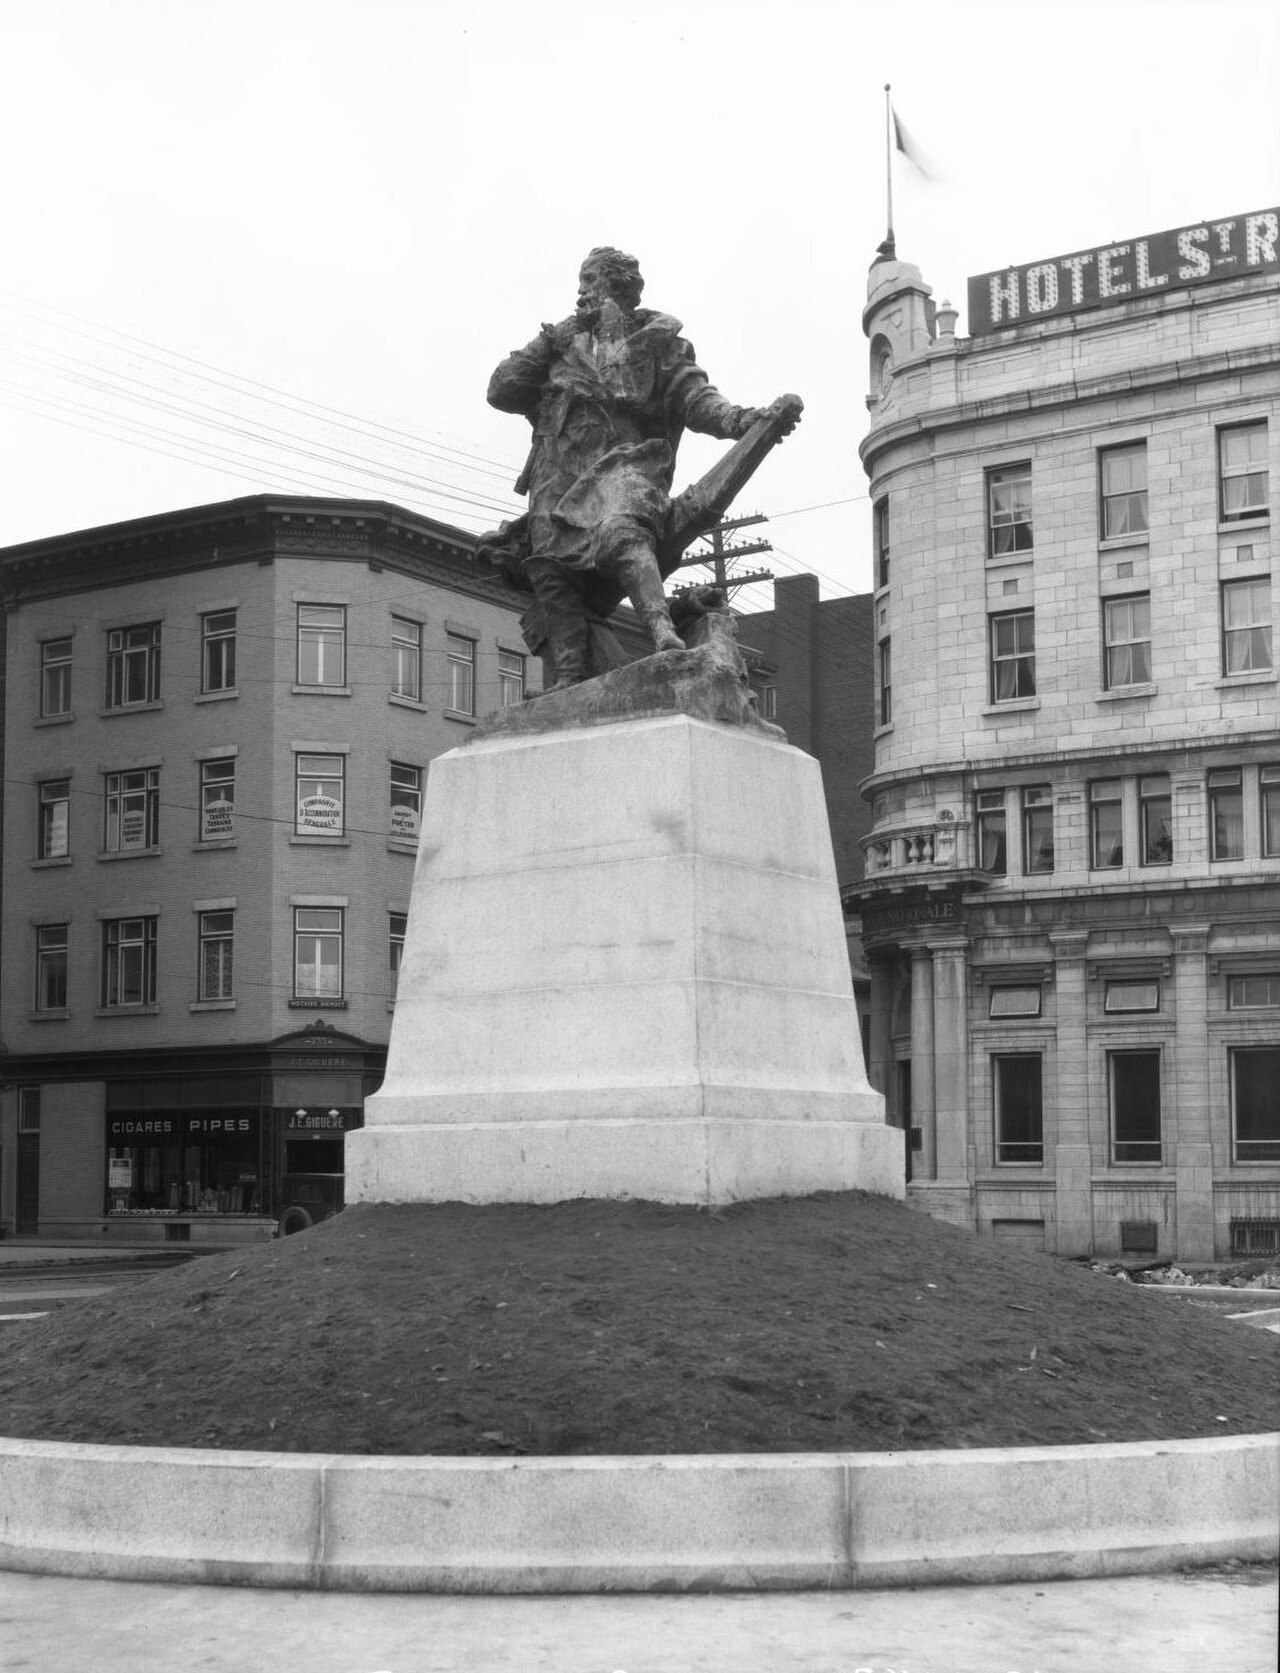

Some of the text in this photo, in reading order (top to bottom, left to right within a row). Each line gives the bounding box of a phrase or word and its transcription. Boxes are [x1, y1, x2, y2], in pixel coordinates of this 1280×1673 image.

[989, 240, 1169, 323] HOTEL
[112, 1119, 250, 1133] CIGARES PIPES
